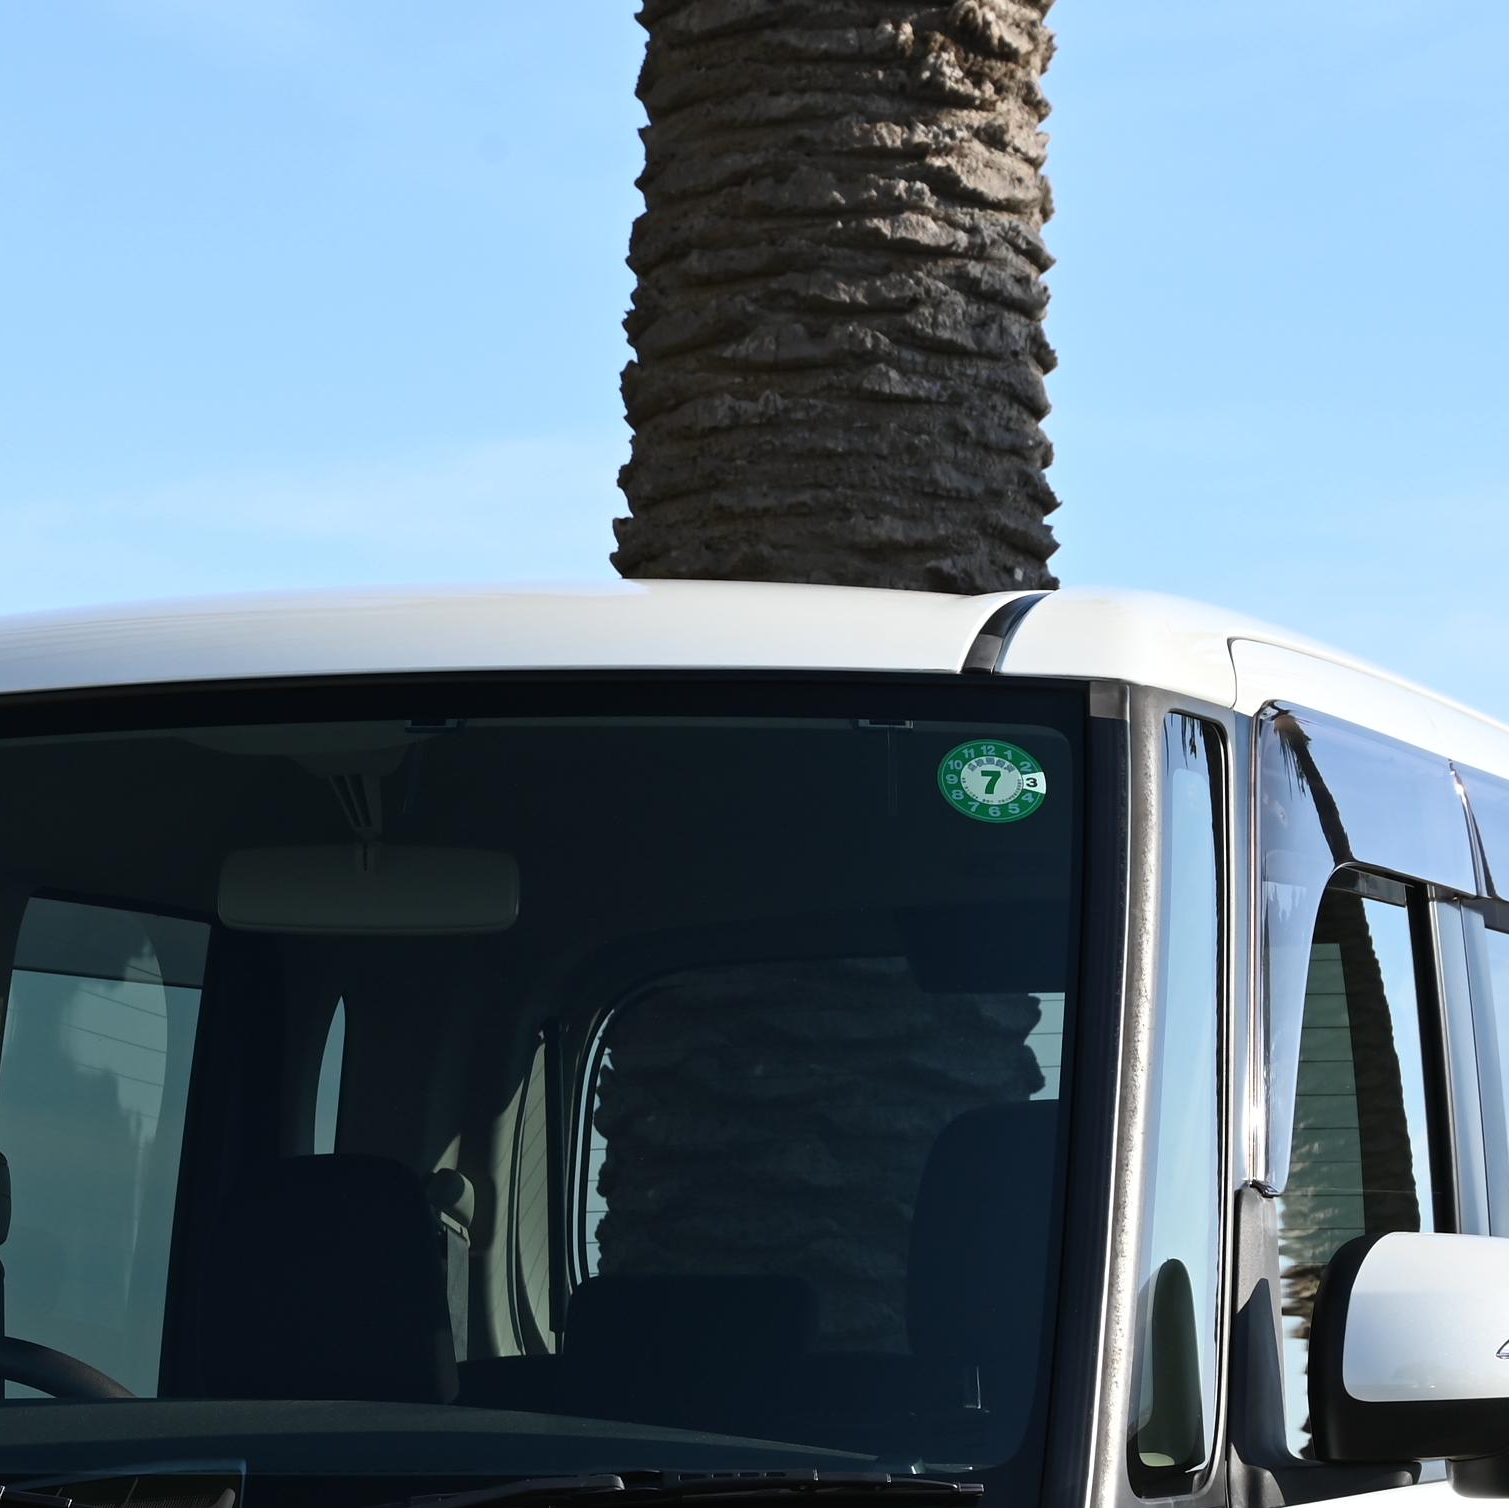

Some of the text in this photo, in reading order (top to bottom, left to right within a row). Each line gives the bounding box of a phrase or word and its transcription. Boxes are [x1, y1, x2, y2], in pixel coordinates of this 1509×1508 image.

[962, 748, 975, 758] 11
[981, 745, 996, 755] 12
[1004, 750, 1012, 760] 1
[948, 760, 963, 770] 10
[1019, 761, 1032, 772] 2
[946, 774, 958, 784] 9
[981, 770, 1001, 795] 7
[1026, 777, 1038, 788] 3
[951, 789, 964, 800] 8
[1021, 792, 1034, 803] 4
[967, 802, 980, 812] 7
[988, 806, 1001, 817] 6
[1008, 803, 1020, 814] 5
